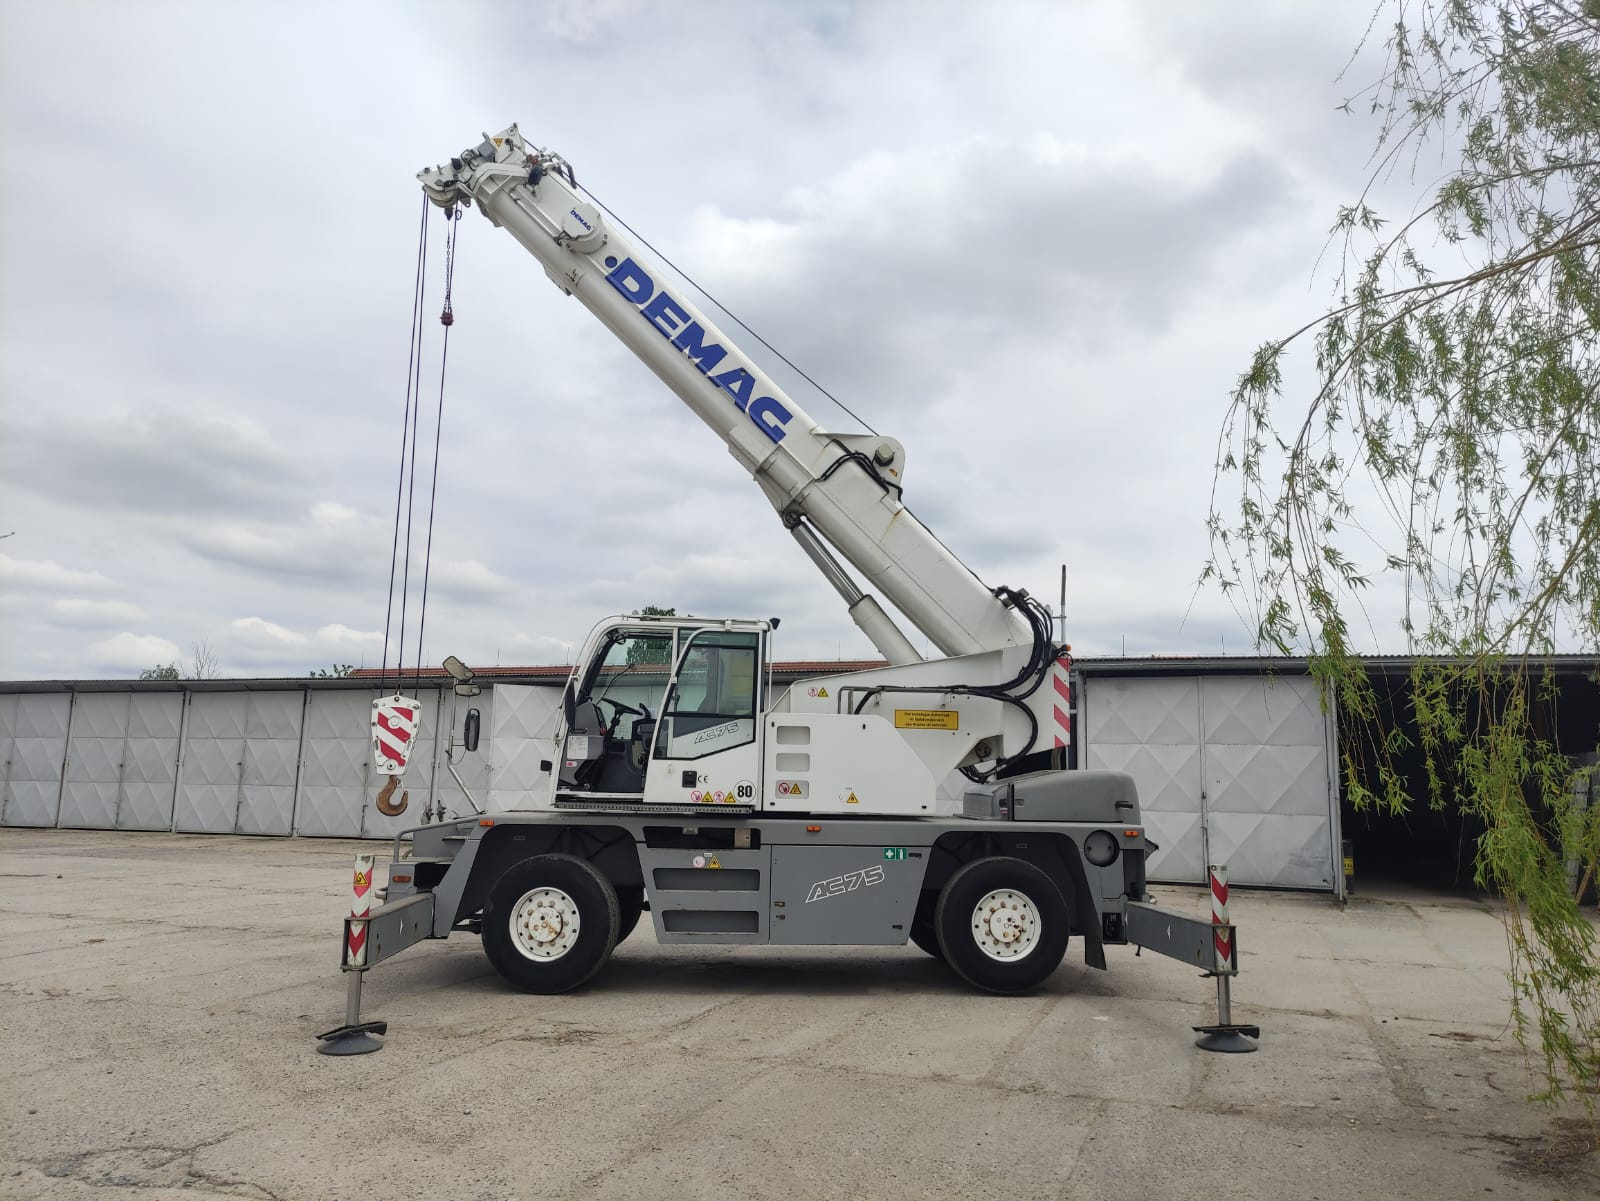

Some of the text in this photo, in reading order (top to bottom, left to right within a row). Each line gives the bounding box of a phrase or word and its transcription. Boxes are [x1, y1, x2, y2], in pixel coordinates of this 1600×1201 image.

[570, 209, 592, 231] DEMAG
[605, 257, 794, 445] DEMAG
[693, 721, 738, 745] AC75
[697, 775, 709, 784] CE
[737, 785, 753, 798] 80
[805, 865, 885, 904] AC75
